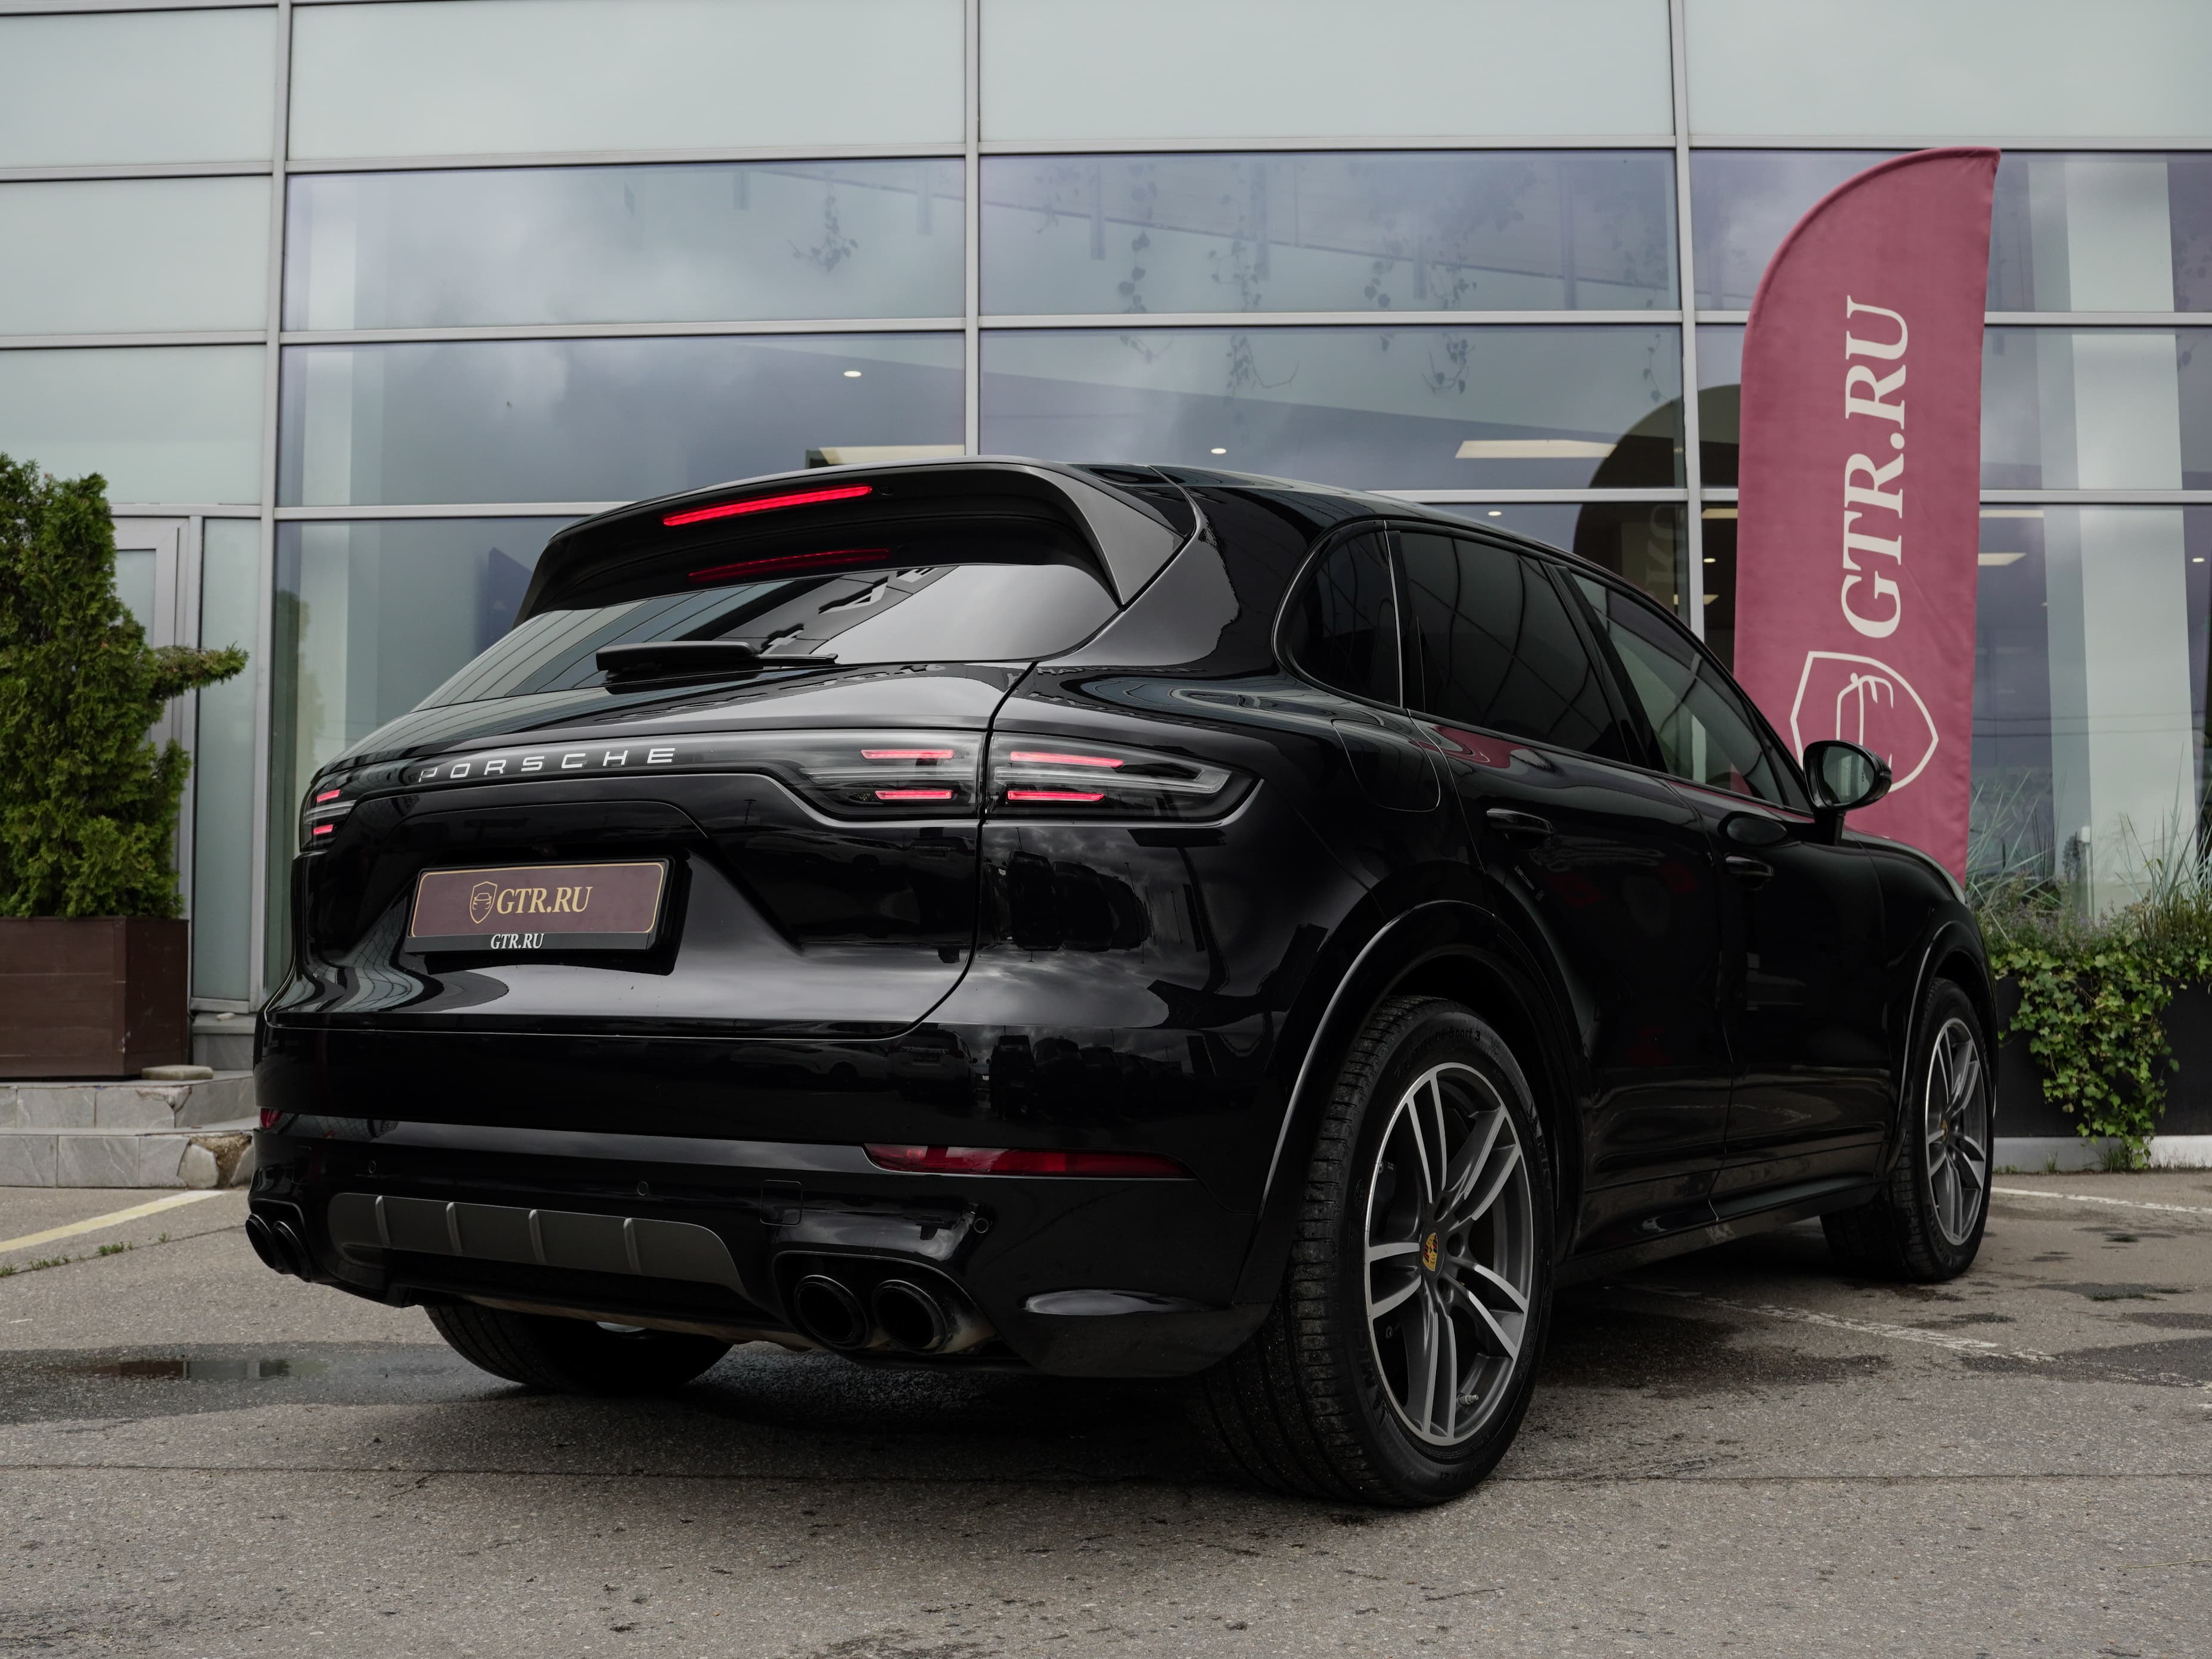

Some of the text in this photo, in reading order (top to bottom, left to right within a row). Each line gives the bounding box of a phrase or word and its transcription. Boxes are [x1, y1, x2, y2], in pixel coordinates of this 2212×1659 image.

[1841, 295, 1909, 641] GTR.RU
[418, 747, 676, 782] PORSCHE
[496, 886, 593, 914] GTR.RU
[490, 933, 545, 949] GTR.RU
[1449, 1026, 1481, 1041] Sport 3
